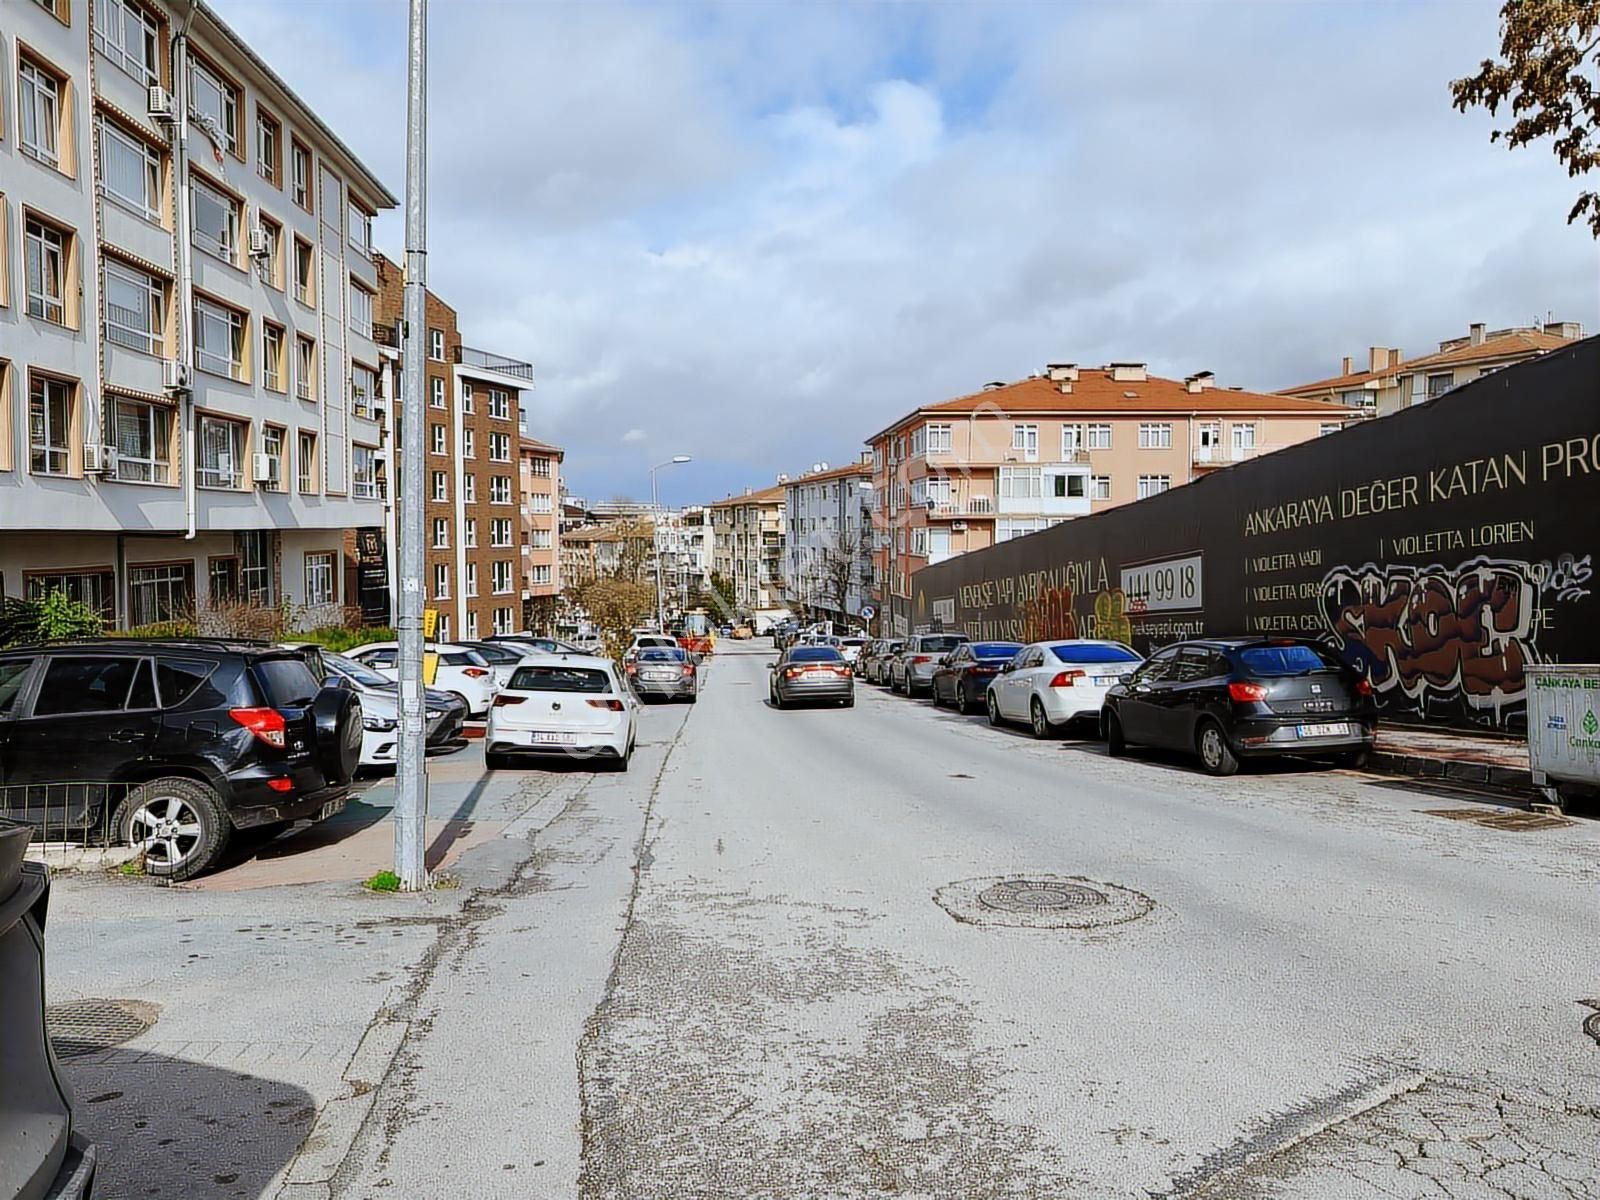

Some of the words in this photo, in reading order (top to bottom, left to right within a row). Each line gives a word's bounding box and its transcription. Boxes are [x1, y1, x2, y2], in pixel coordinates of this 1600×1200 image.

[1341, 475, 1418, 519] DEĞER
[1429, 450, 1526, 502] KATAN
[1392, 529, 1465, 556] VIOLETTA
[1470, 519, 1535, 547] LORIEN
[1155, 568, 1174, 601] 99
[1180, 565, 1195, 599] 18
